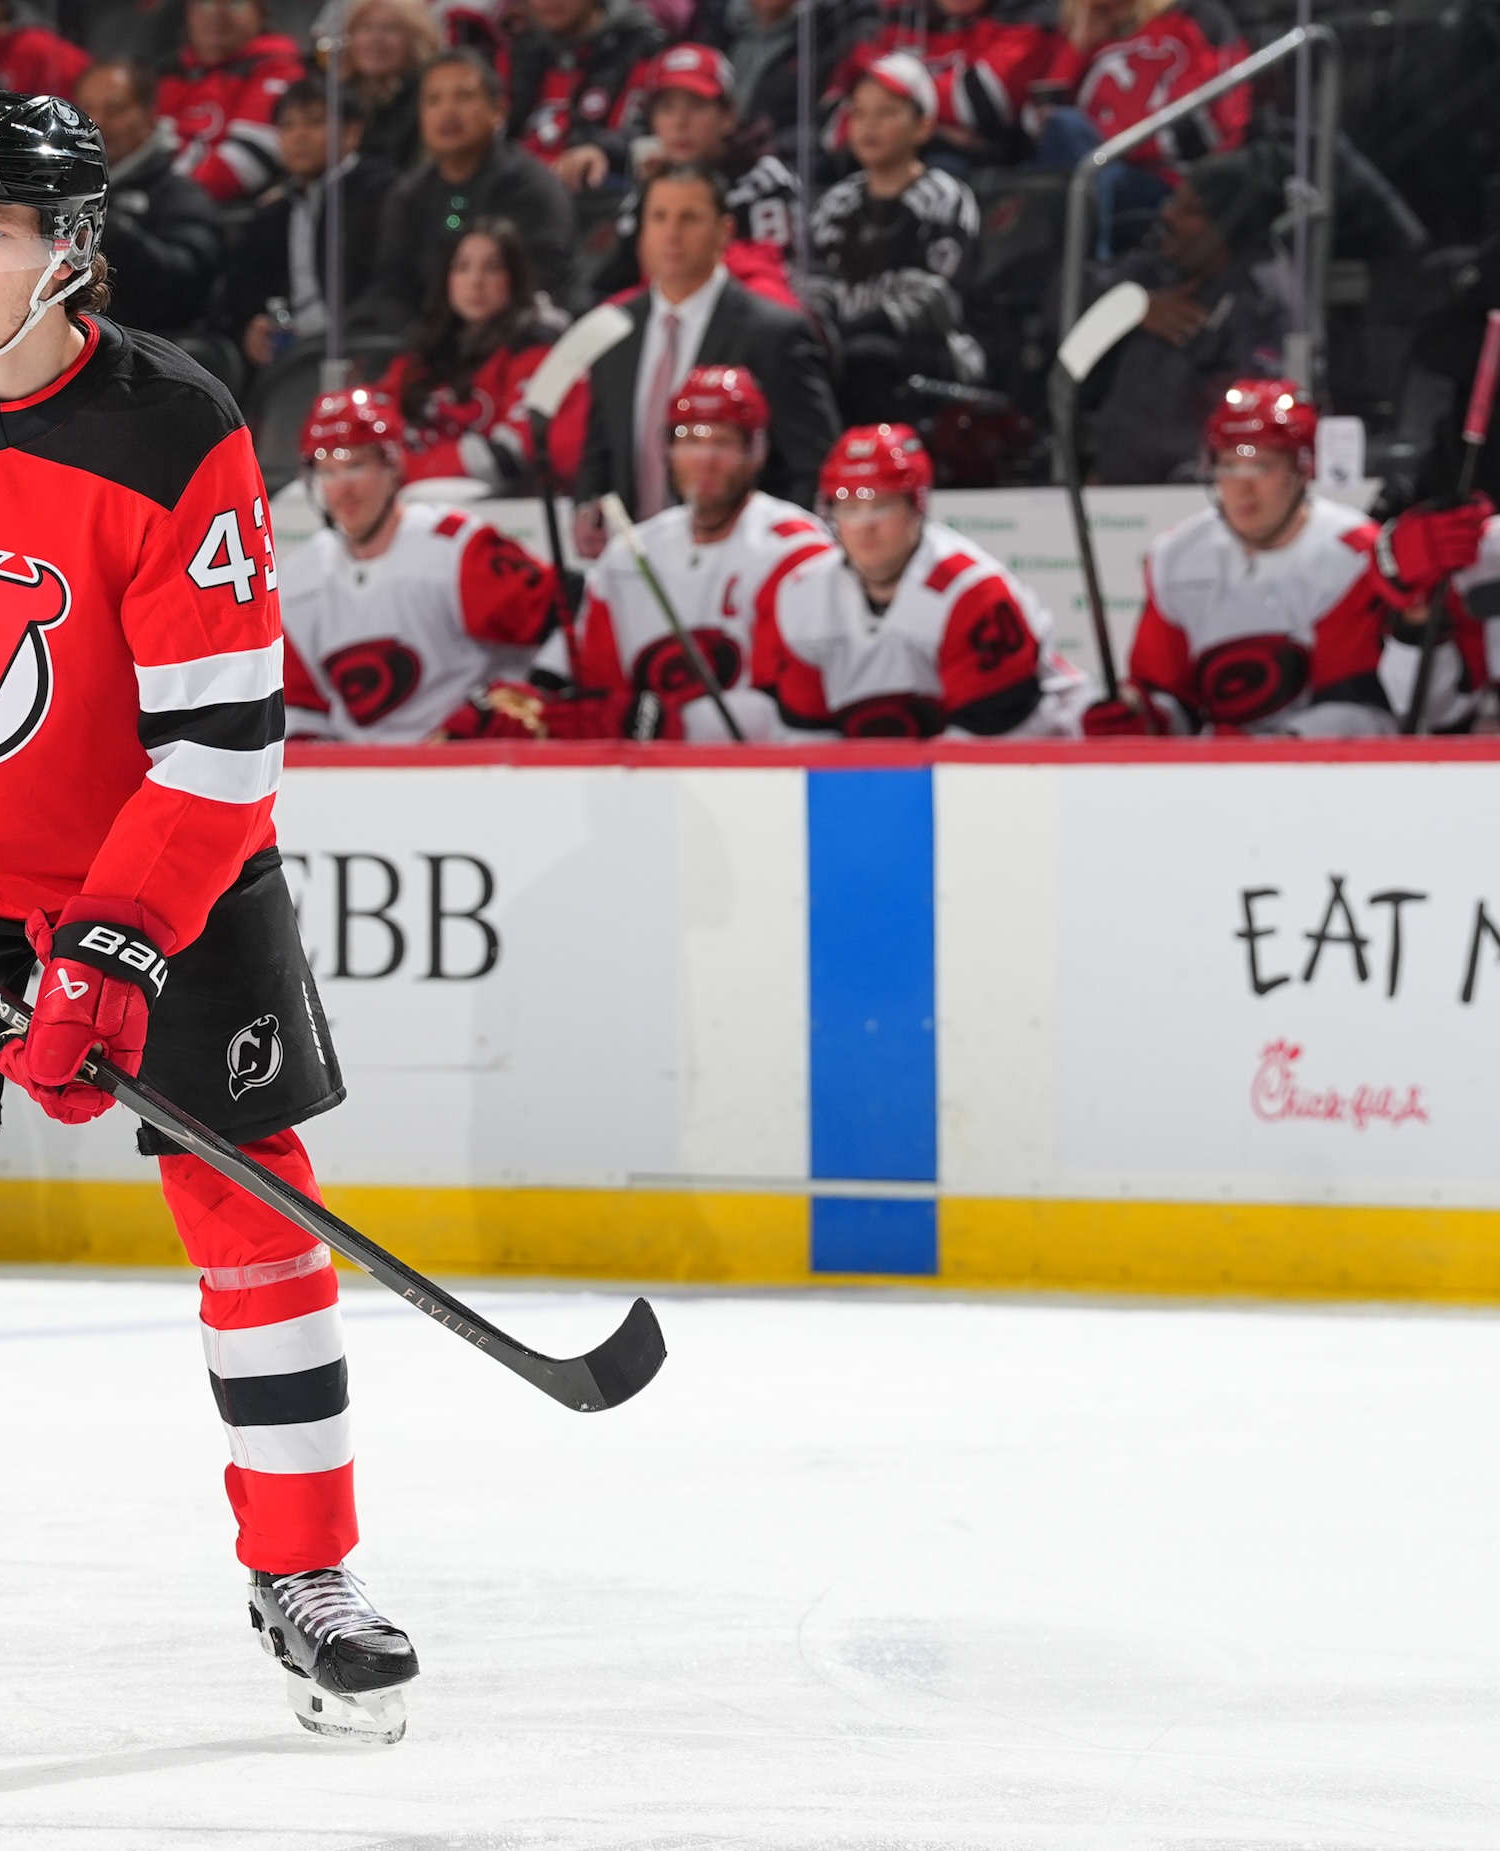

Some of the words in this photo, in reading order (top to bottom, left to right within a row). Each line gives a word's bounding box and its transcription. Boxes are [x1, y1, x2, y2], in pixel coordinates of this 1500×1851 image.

[185, 494, 279, 605] 43
[1235, 872, 1428, 998] EAT
[402, 1287, 489, 1349] FLYLITE
